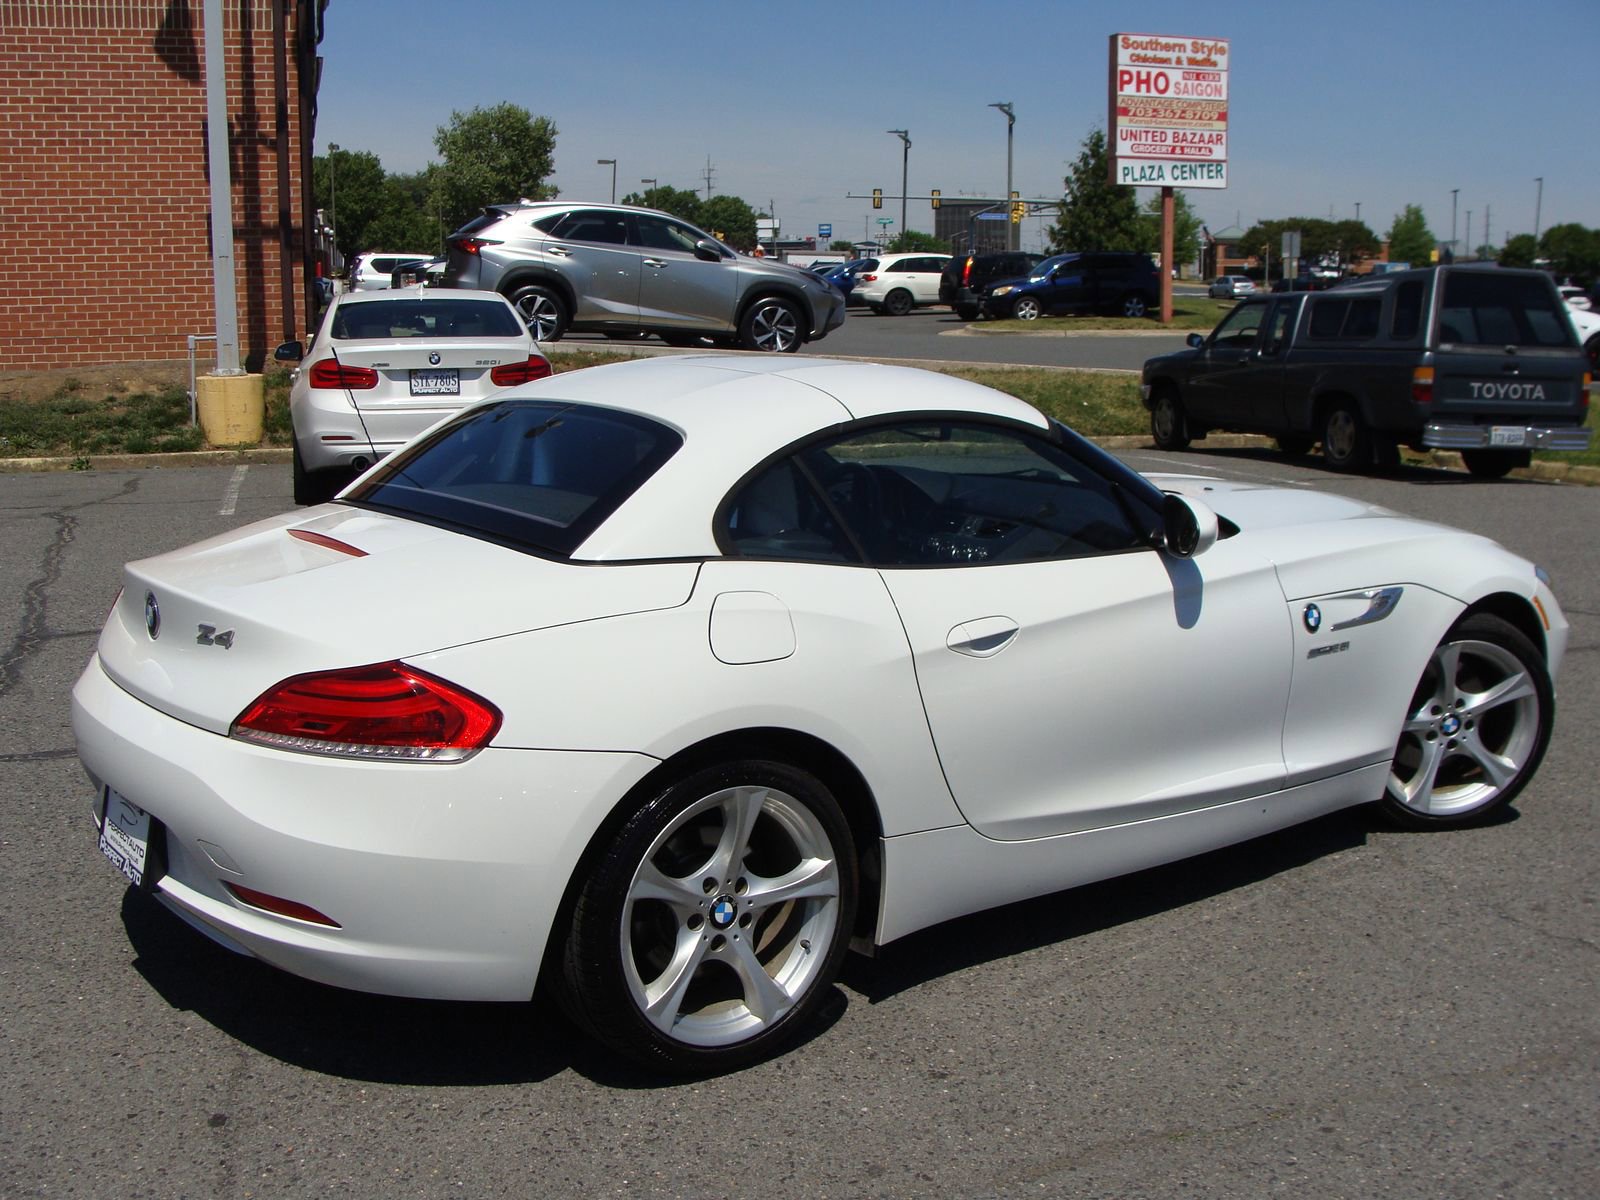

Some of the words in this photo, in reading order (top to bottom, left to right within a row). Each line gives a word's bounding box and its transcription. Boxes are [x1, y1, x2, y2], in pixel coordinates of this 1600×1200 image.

[1121, 36, 1186, 53] Southern
[1190, 40, 1227, 57] Style
[1119, 70, 1170, 95] PHO
[1173, 81, 1223, 97] SAIGON
[1127, 108, 1219, 120] 703-367-8709
[1120, 129, 1168, 143] UNITED
[1172, 131, 1224, 146] BAZAAR
[1132, 144, 1172, 154] GROCERY
[1174, 145, 1182, 154] &
[1183, 145, 1212, 156] HALAL
[1122, 164, 1165, 183] PLAZA
[1171, 162, 1224, 181] CENTER
[1470, 382, 1545, 400] TOYOTA
[196, 623, 235, 650] Z4
[99, 834, 123, 869] PERFECT
[122, 857, 142, 886] AUTO
